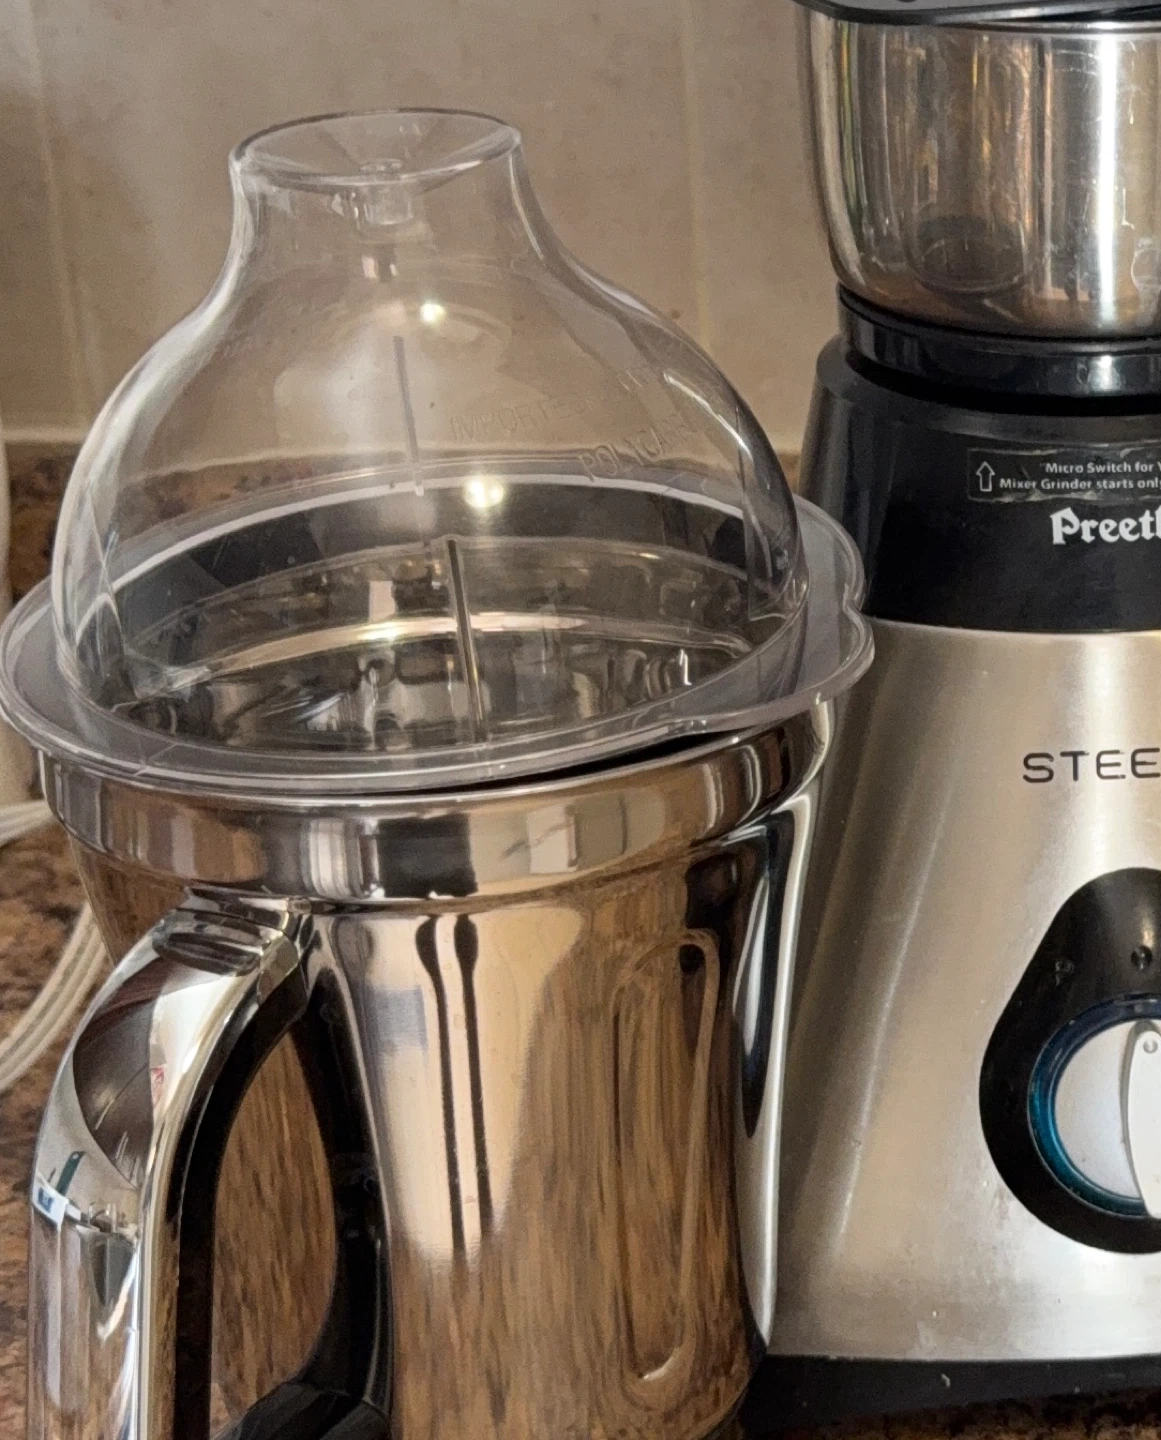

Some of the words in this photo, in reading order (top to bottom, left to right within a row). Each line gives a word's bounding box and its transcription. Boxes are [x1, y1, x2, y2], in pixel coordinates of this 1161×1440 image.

[1086, 461, 1132, 474] Switch
[1134, 461, 1154, 473] for
[999, 478, 1037, 489] Mixer
[1040, 478, 1092, 490] Grinder
[1096, 478, 1134, 490] starts
